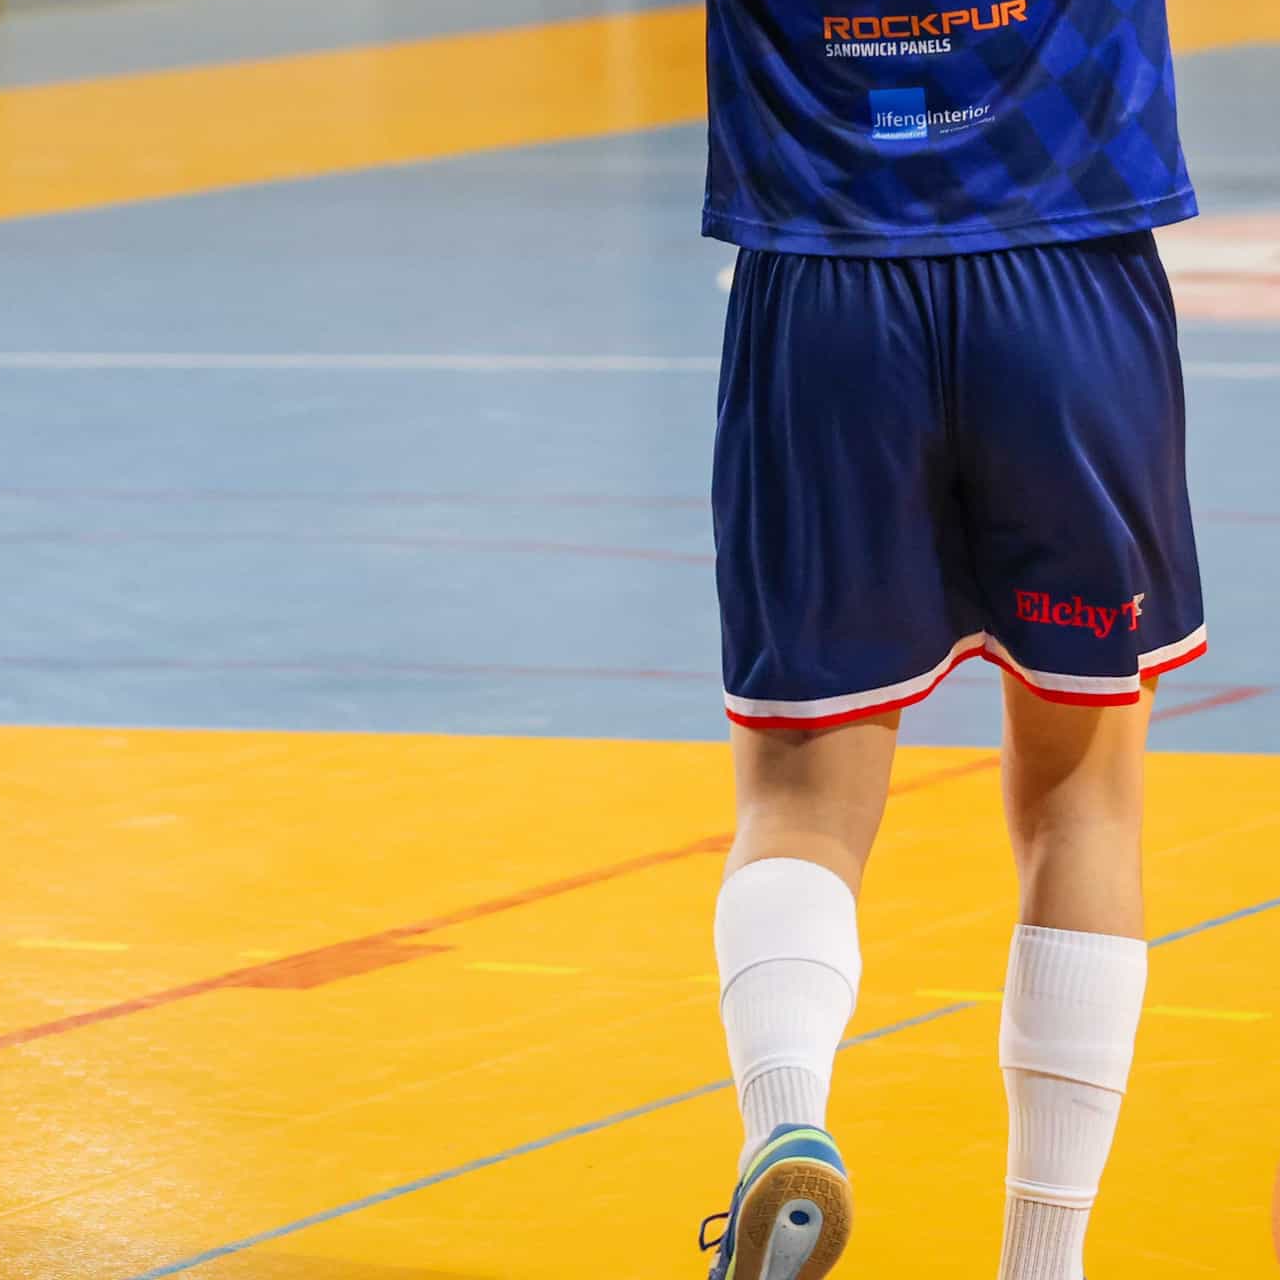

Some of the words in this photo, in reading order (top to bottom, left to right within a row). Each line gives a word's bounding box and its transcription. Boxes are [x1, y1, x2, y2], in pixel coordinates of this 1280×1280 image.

[825, 42, 897, 57] SANDWICH
[900, 38, 951, 55] PANELS
[1015, 590, 1117, 638] Elchy
